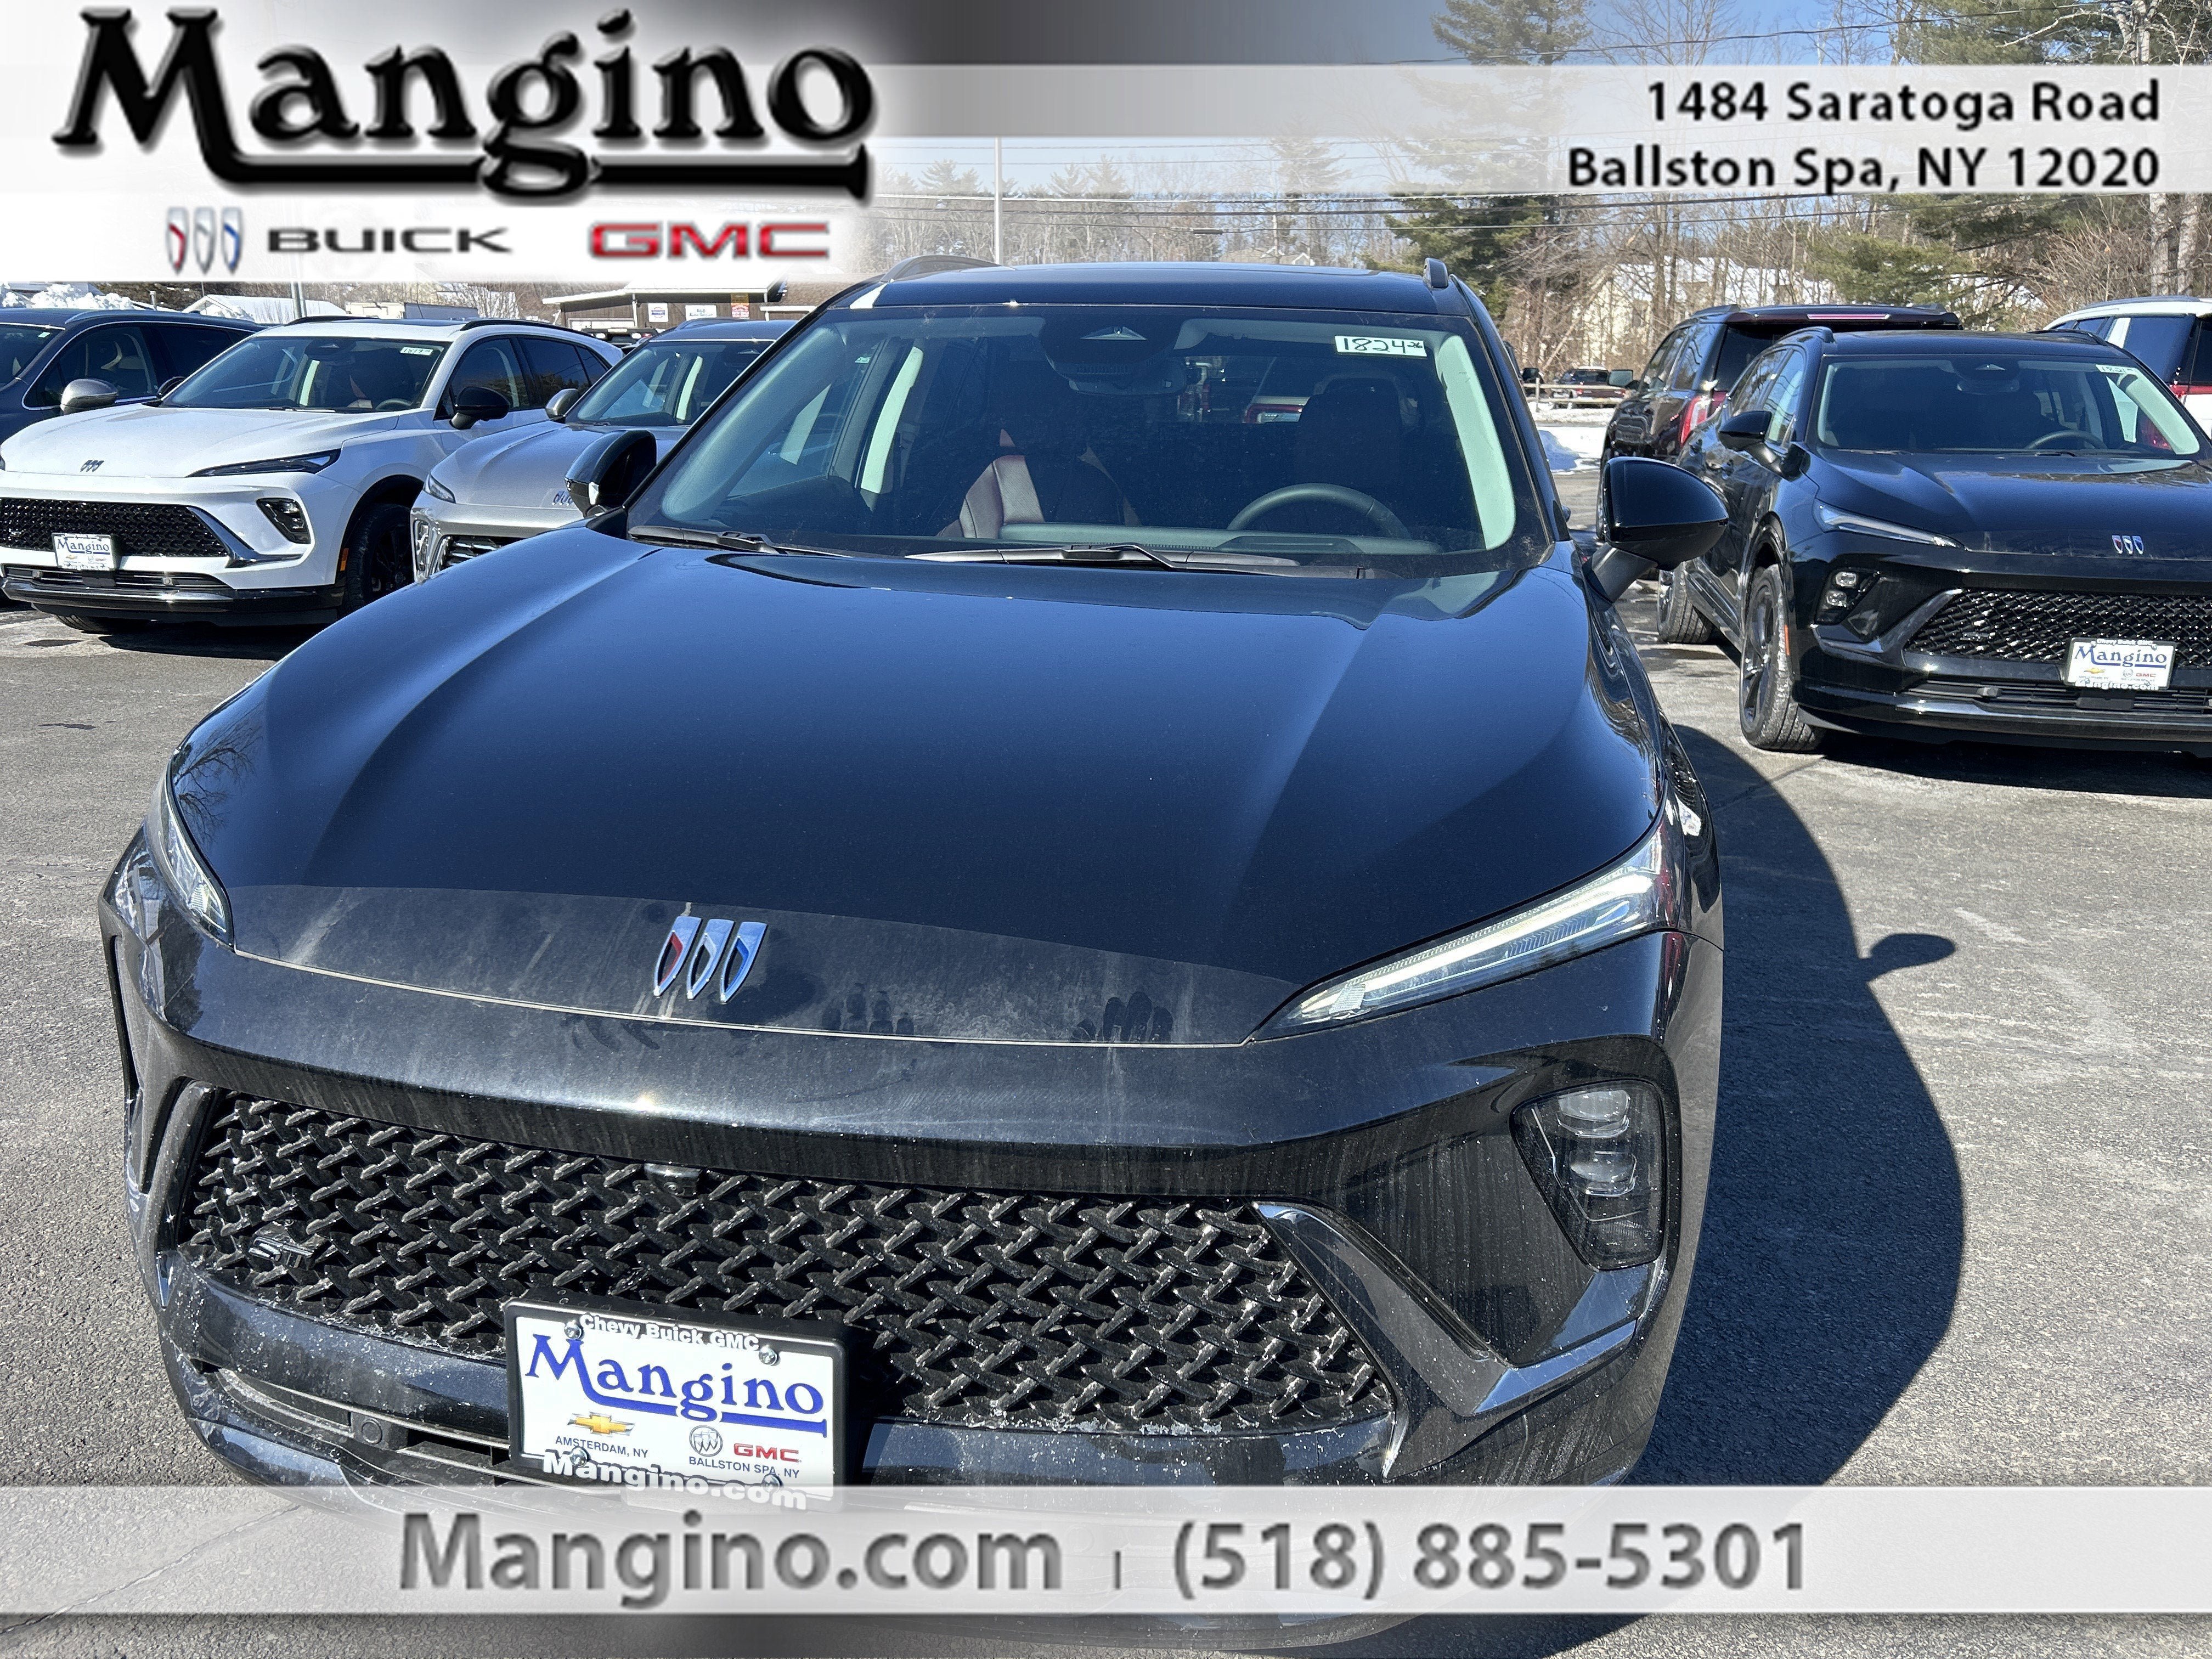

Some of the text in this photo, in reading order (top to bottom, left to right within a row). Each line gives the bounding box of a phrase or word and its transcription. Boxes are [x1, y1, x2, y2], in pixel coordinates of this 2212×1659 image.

[1344, 337, 1406, 354] 1824
[57, 539, 110, 555] Mangino
[2074, 646, 2167, 669] Mangino
[580, 1314, 760, 1351] Chevy Buick GMC
[524, 1334, 827, 1437] Mangino
[555, 1435, 648, 1458] AMSTERDAM, NY
[733, 1443, 799, 1463] GMC
[543, 1448, 807, 1510] Mangino.com
[689, 1456, 751, 1472] BALLSTON
[784, 1468, 800, 1479] NY
